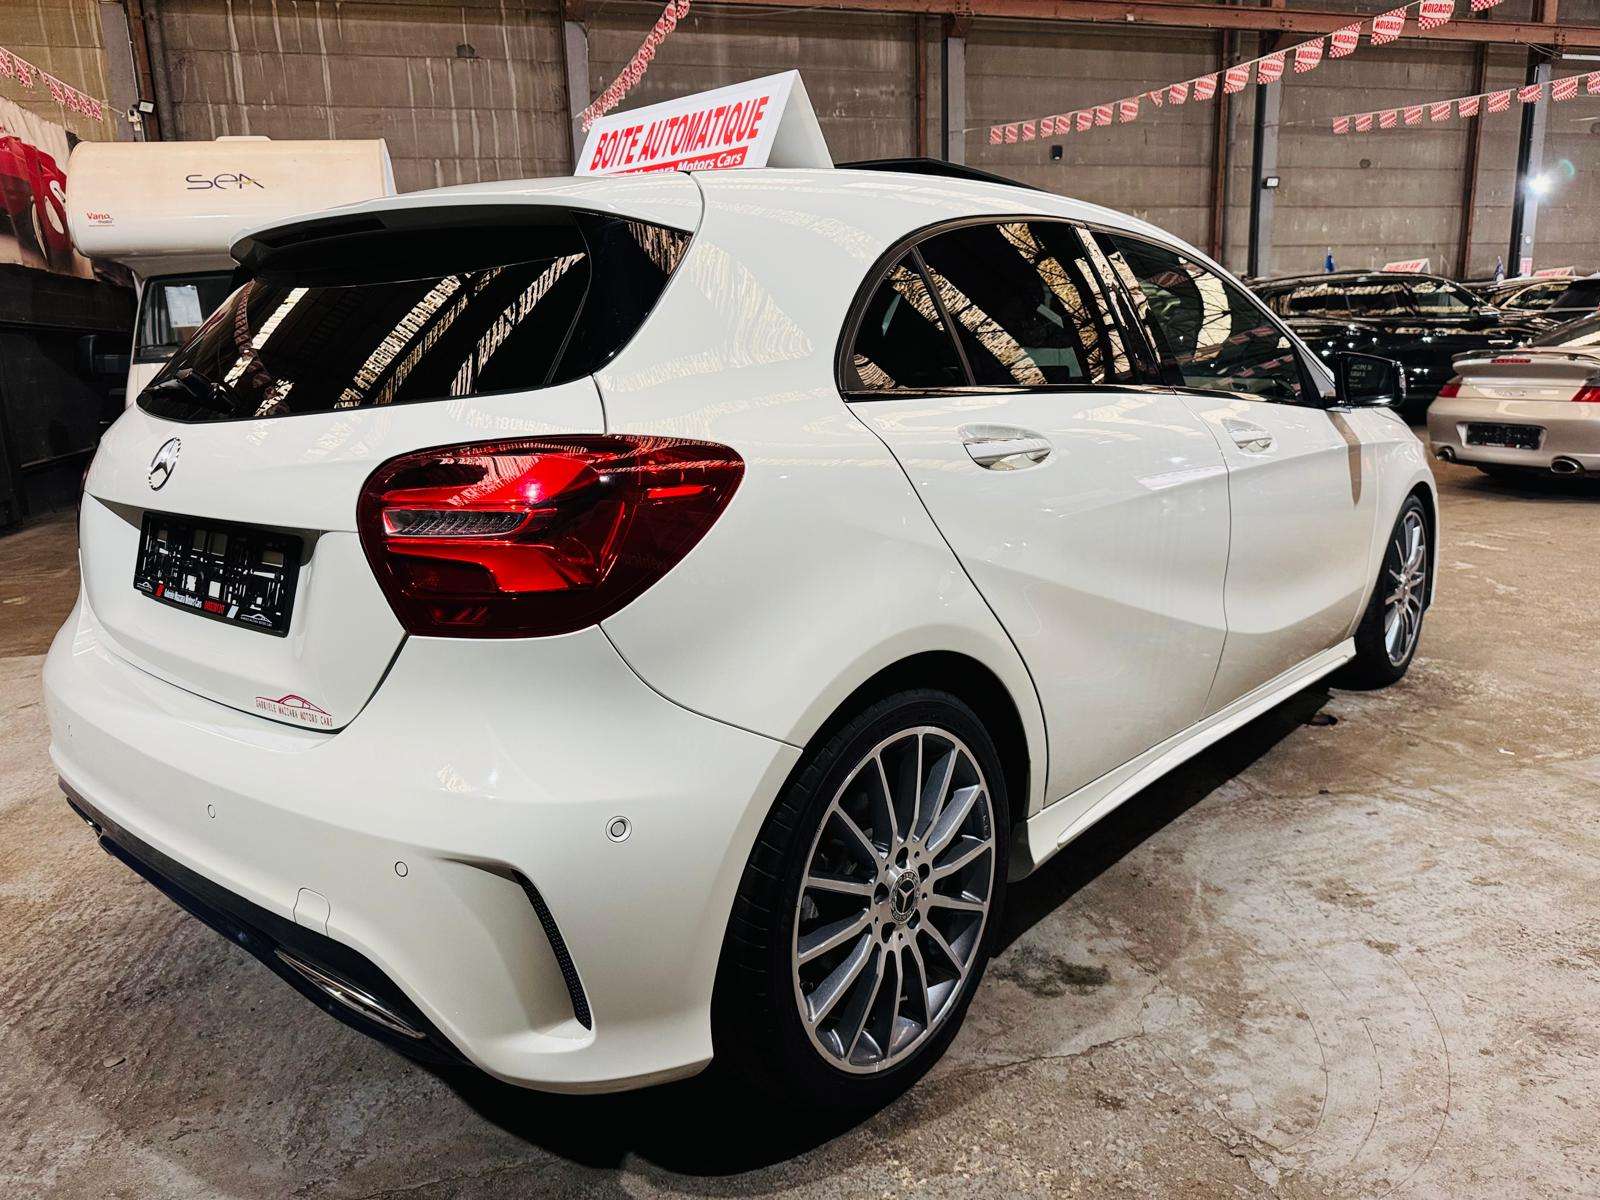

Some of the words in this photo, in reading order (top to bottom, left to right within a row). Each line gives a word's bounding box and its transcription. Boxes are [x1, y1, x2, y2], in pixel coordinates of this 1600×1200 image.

[590, 125, 643, 171] BOITE
[638, 95, 769, 162] AUTOMATIQUE
[677, 156, 715, 172] Motors
[717, 152, 743, 168] Cars
